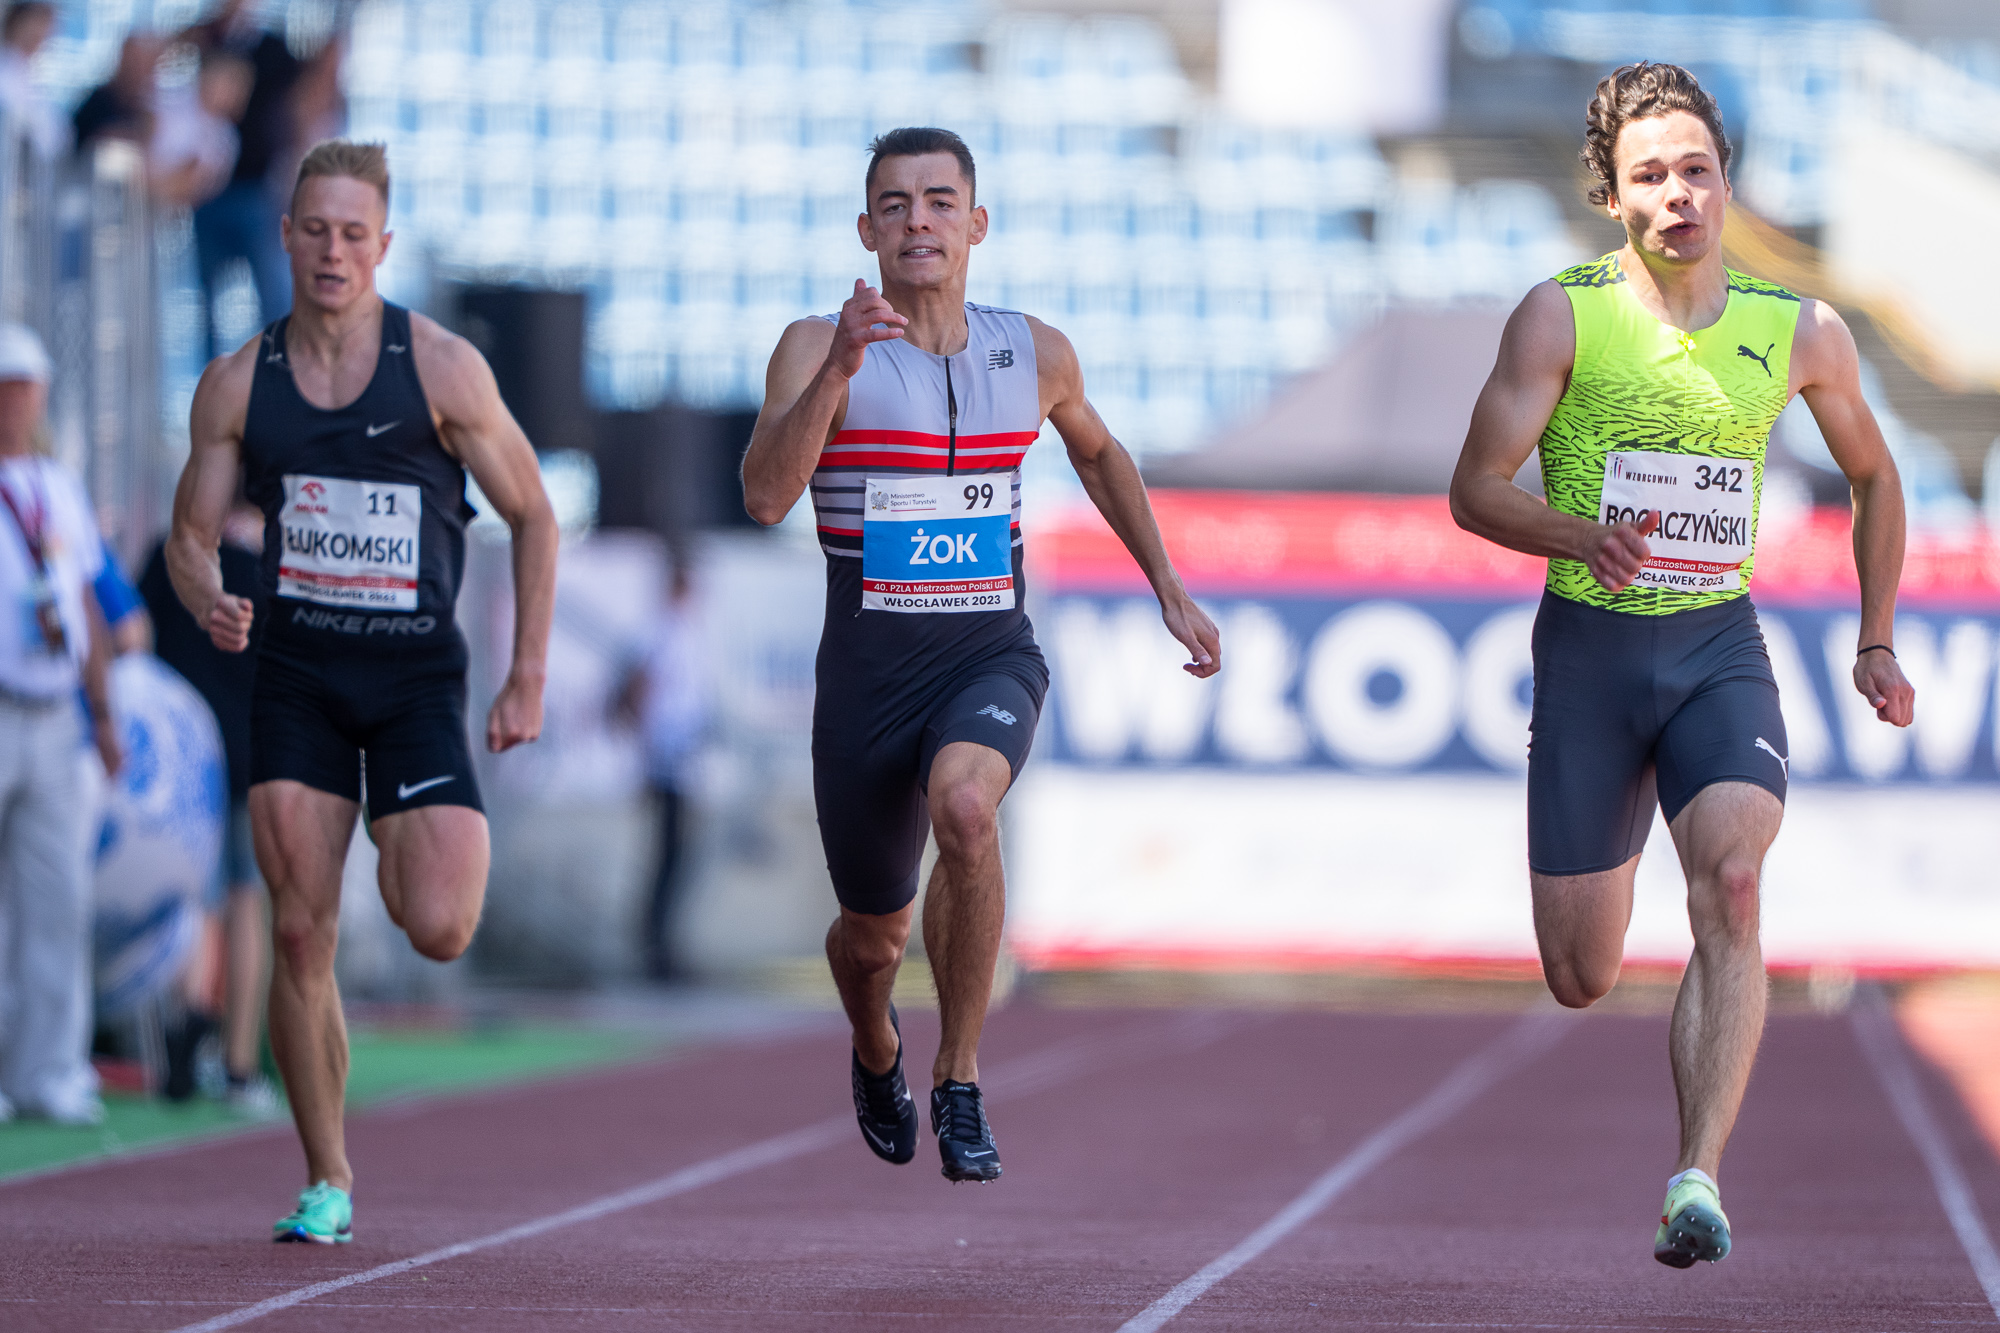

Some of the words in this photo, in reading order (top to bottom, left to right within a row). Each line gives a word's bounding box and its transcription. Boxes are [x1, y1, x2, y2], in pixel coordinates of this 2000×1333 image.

[1625, 471, 1678, 486] WZORCOWNIA
[1694, 464, 1743, 493] 342
[367, 491, 398, 516] 11
[890, 492, 925, 500] Ministerstwo
[912, 498, 937, 506] Turystyki
[963, 483, 994, 511] 99
[286, 525, 413, 565] ŁUKOMSKI
[909, 528, 979, 565] ŻOK
[1643, 558, 1696, 571] Mistrzostwa
[873, 583, 888, 592] 40.
[890, 584, 912, 593] PZLA
[913, 583, 967, 593] Mistrzostwa
[968, 581, 993, 592] Polski
[994, 580, 1008, 589] U23
[1698, 575, 1725, 587] 2023
[883, 596, 969, 608] WŁOCŁAWEK
[971, 594, 1001, 606] 2023
[292, 607, 366, 635] NIKE
[366, 615, 437, 636] PRO
